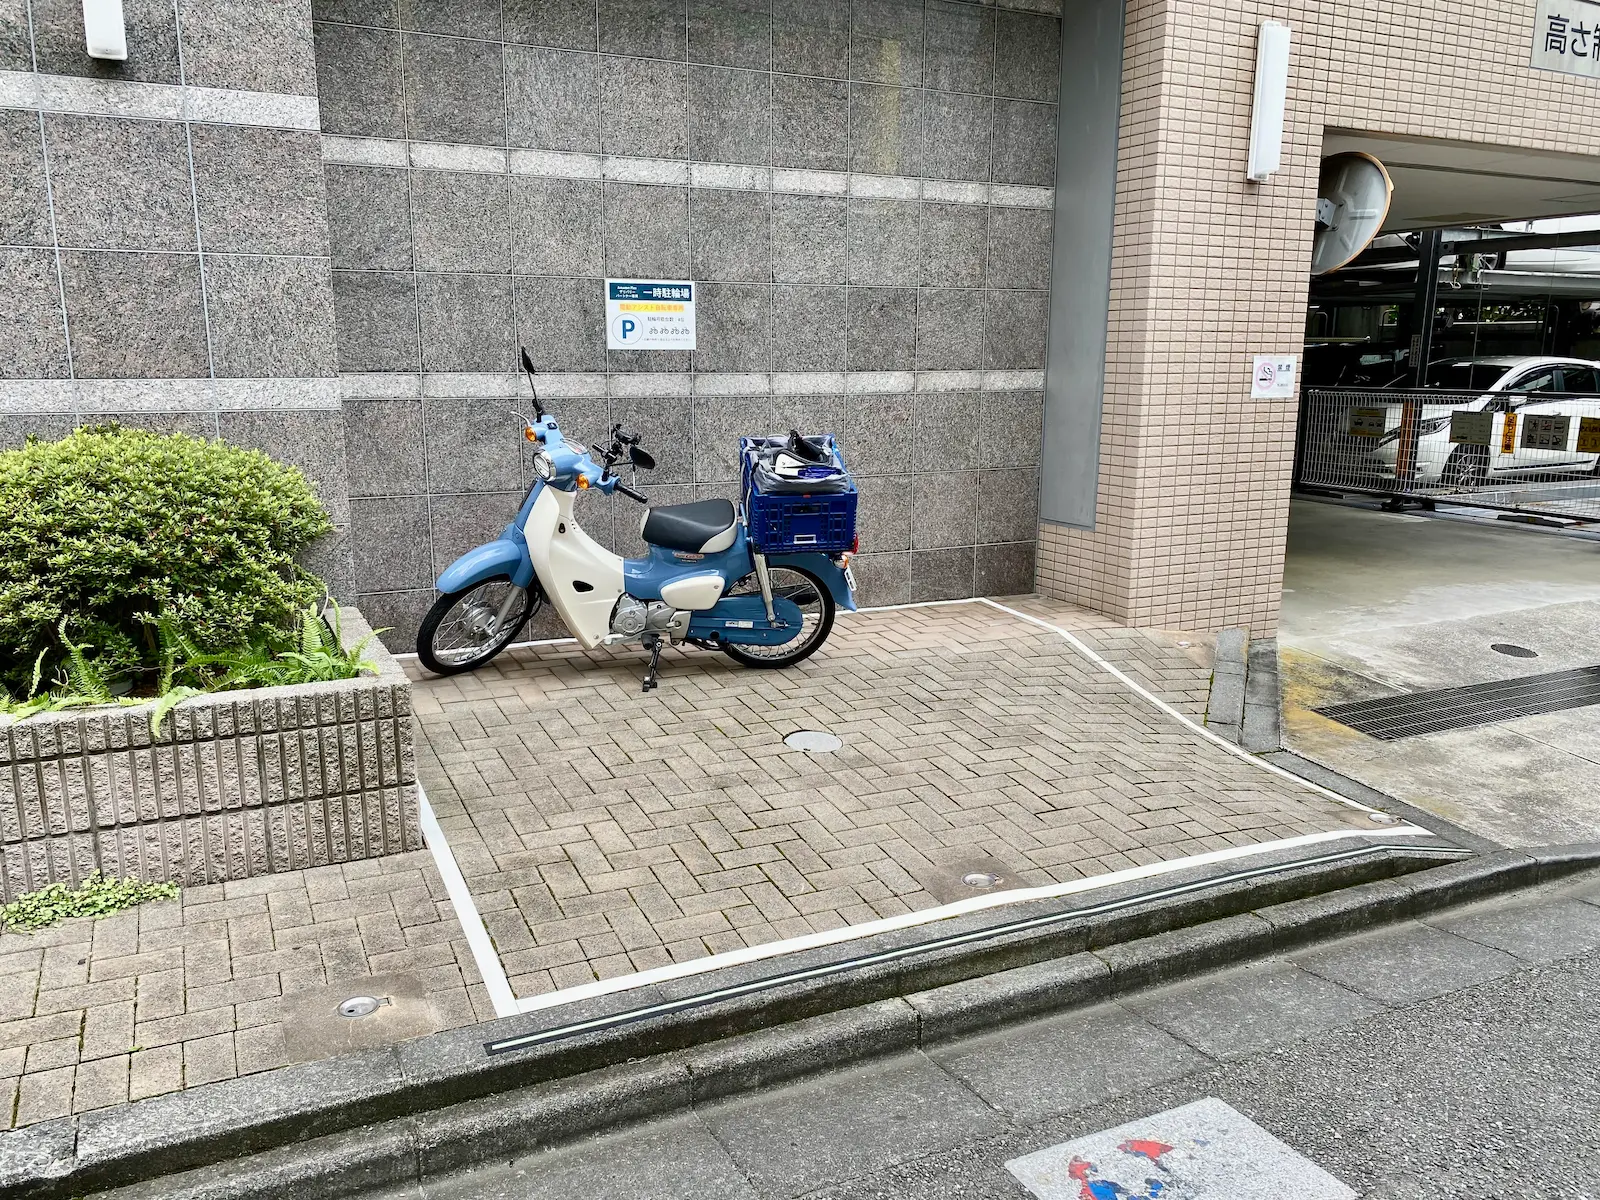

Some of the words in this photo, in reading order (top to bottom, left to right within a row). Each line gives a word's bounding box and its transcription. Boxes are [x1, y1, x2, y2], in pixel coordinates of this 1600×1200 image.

[643, 287, 690, 299] 一時駐輪場
[622, 319, 635, 339] P
